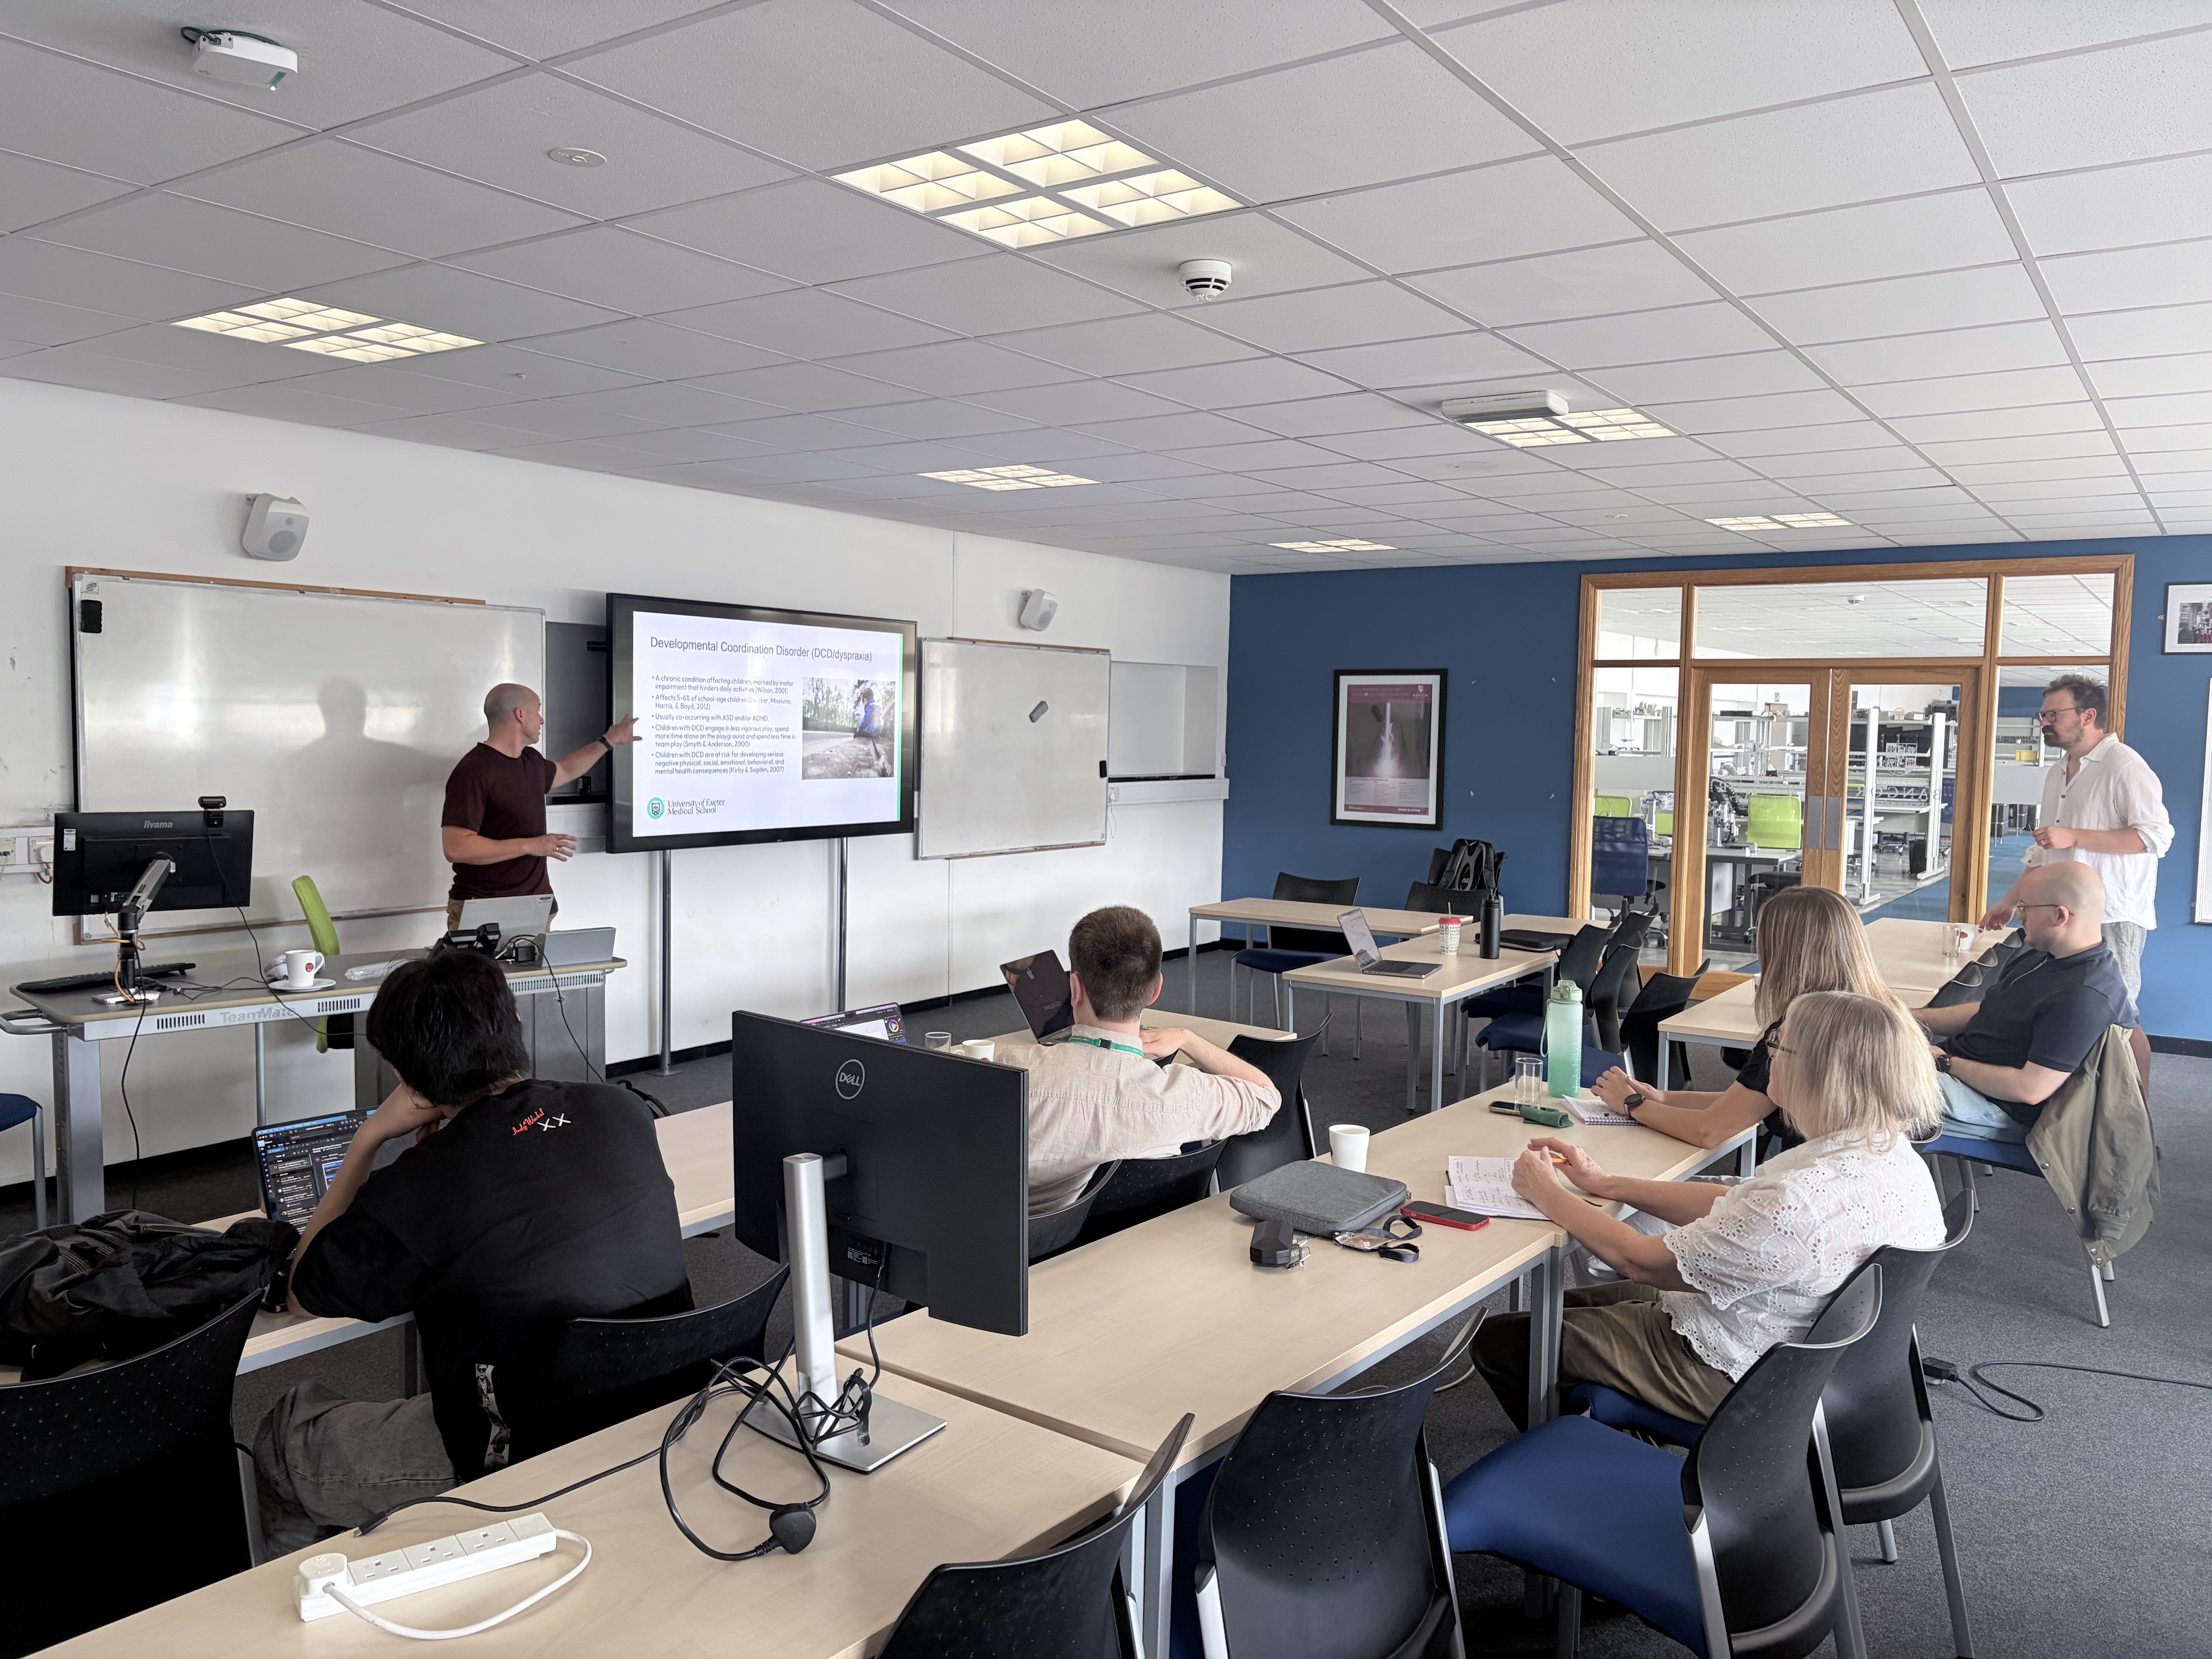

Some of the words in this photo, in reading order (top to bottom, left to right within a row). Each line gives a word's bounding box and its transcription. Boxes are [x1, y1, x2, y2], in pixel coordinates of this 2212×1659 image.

[651, 637, 718, 651] Developmental
[721, 642, 773, 654] Coordination
[776, 646, 809, 657] Disorder
[812, 648, 872, 663] (DCD/dyspraxia)
[707, 677, 730, 685] affecting
[720, 685, 732, 693] daily
[668, 800, 697, 808] University
[699, 798, 705, 807] of
[668, 807, 693, 816] Medical
[696, 806, 716, 814] School
[220, 1007, 295, 1023] TeamMate
[839, 1072, 860, 1086] DELL
